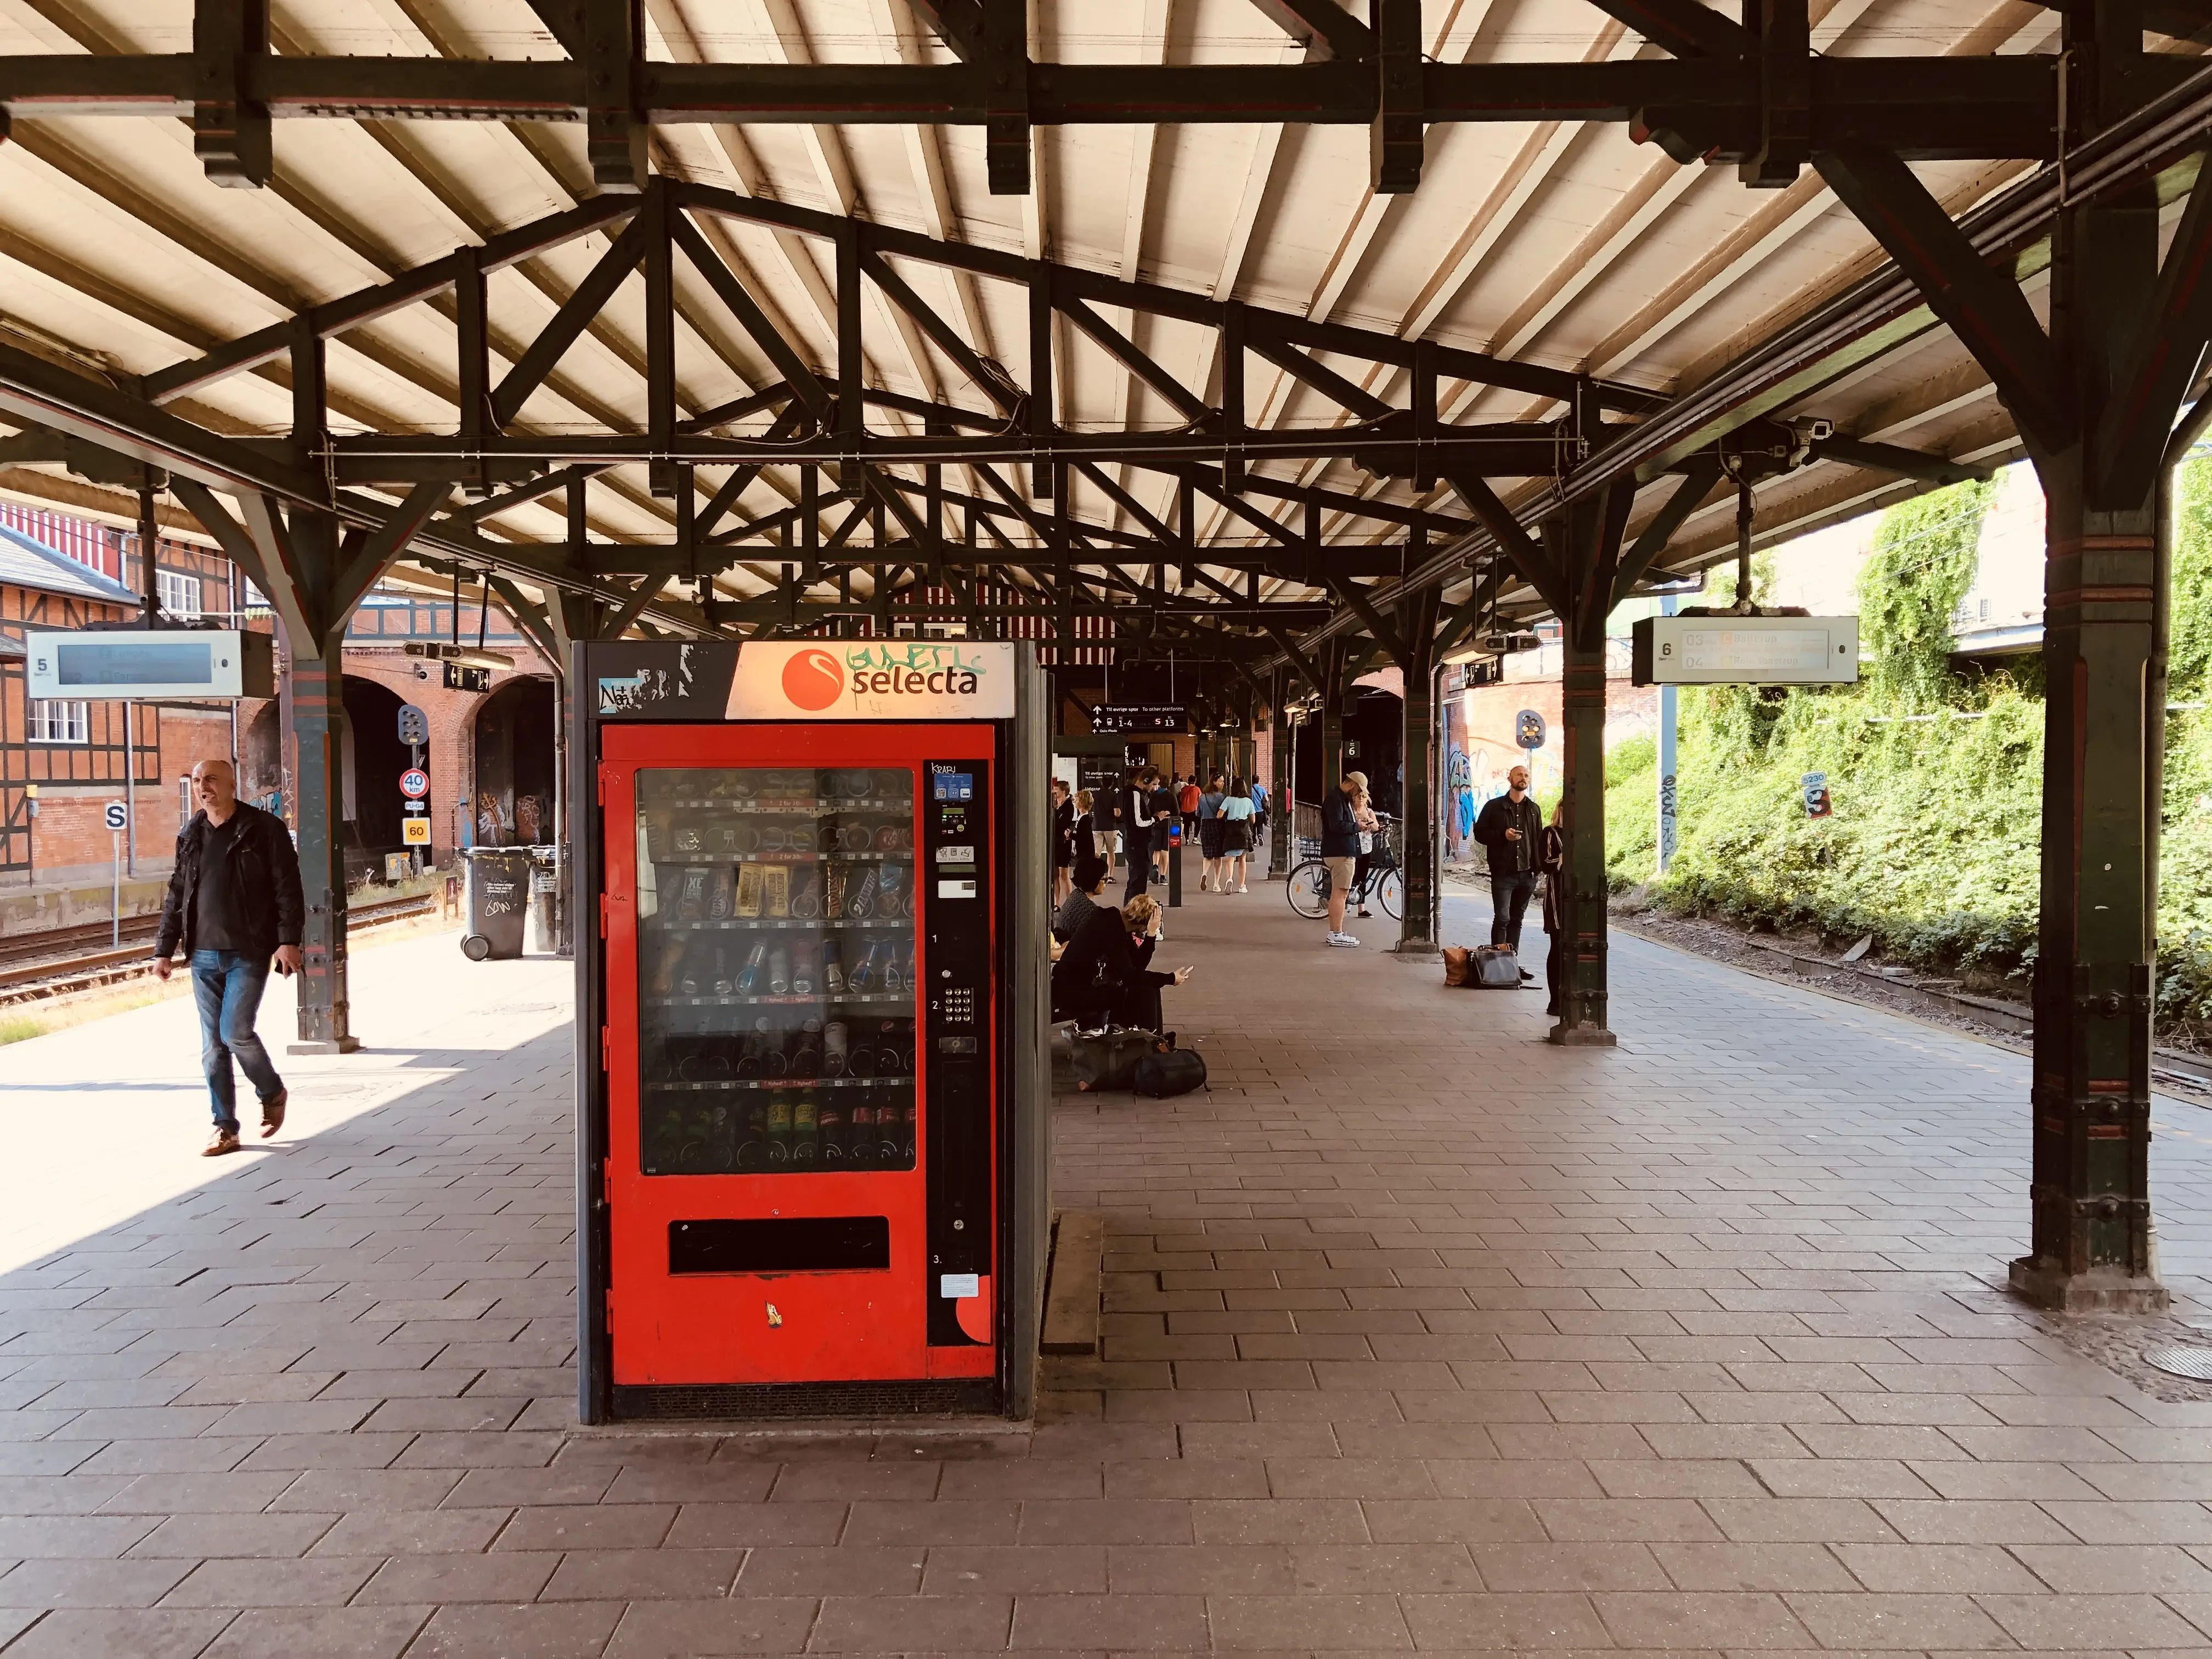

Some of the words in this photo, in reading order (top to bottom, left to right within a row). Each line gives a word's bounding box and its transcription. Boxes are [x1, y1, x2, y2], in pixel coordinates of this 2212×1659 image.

[1686, 634, 1703, 646] 03
[1662, 643, 1672, 656] 6
[38, 658, 47, 671] 5
[1686, 657, 1703, 668] 04
[851, 667, 977, 693] selecta
[1348, 747, 1355, 755] 6
[404, 775, 423, 786] 40
[1803, 774, 1824, 784] 5230
[1807, 789, 1831, 815] S
[106, 805, 125, 827] S
[409, 827, 424, 836] 60
[933, 1255, 942, 1263] 3.
